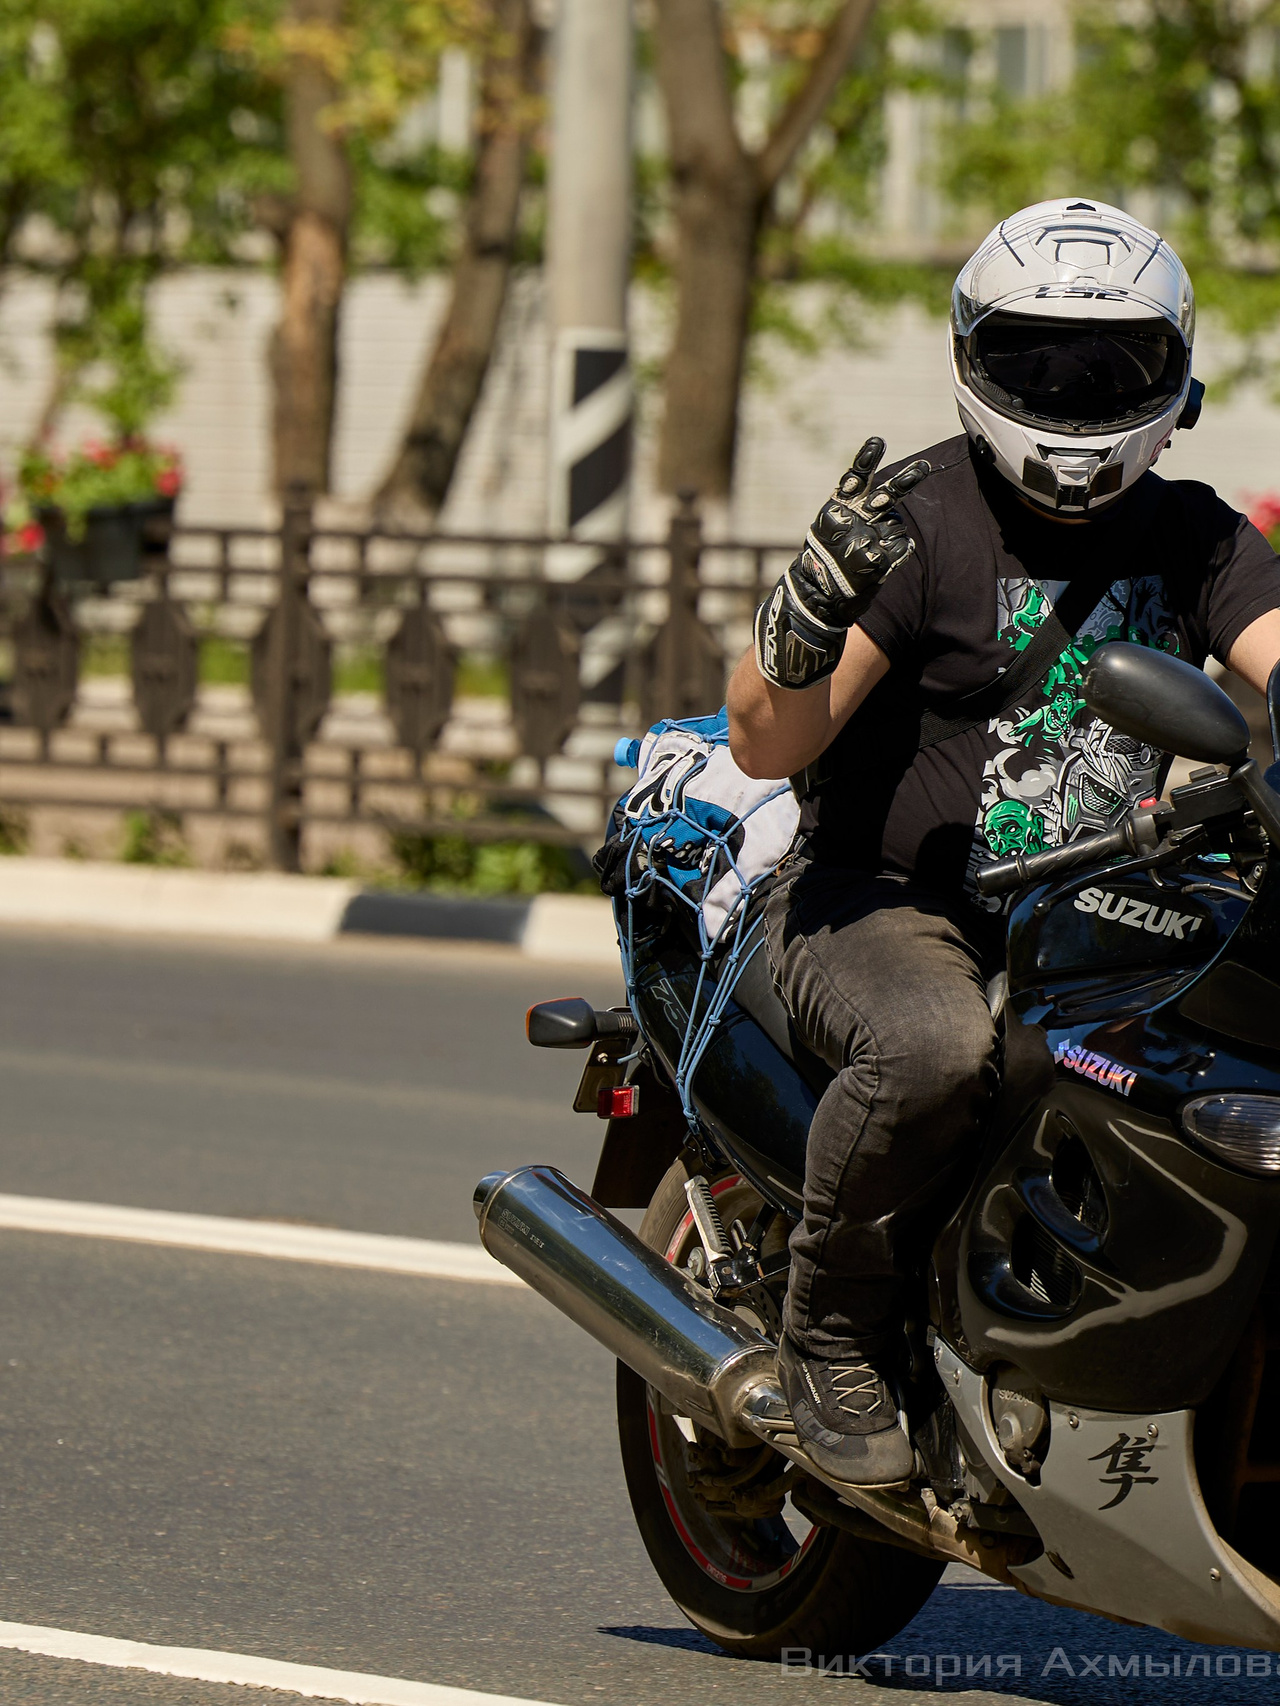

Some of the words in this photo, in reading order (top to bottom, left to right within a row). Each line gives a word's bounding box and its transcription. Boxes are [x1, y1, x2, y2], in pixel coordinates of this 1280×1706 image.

[1035, 286, 1129, 303] LS2
[1073, 886, 1203, 942] SUZUKI
[1063, 1045, 1138, 1097] SUZUKI
[1087, 1432, 1159, 1510] 隼
